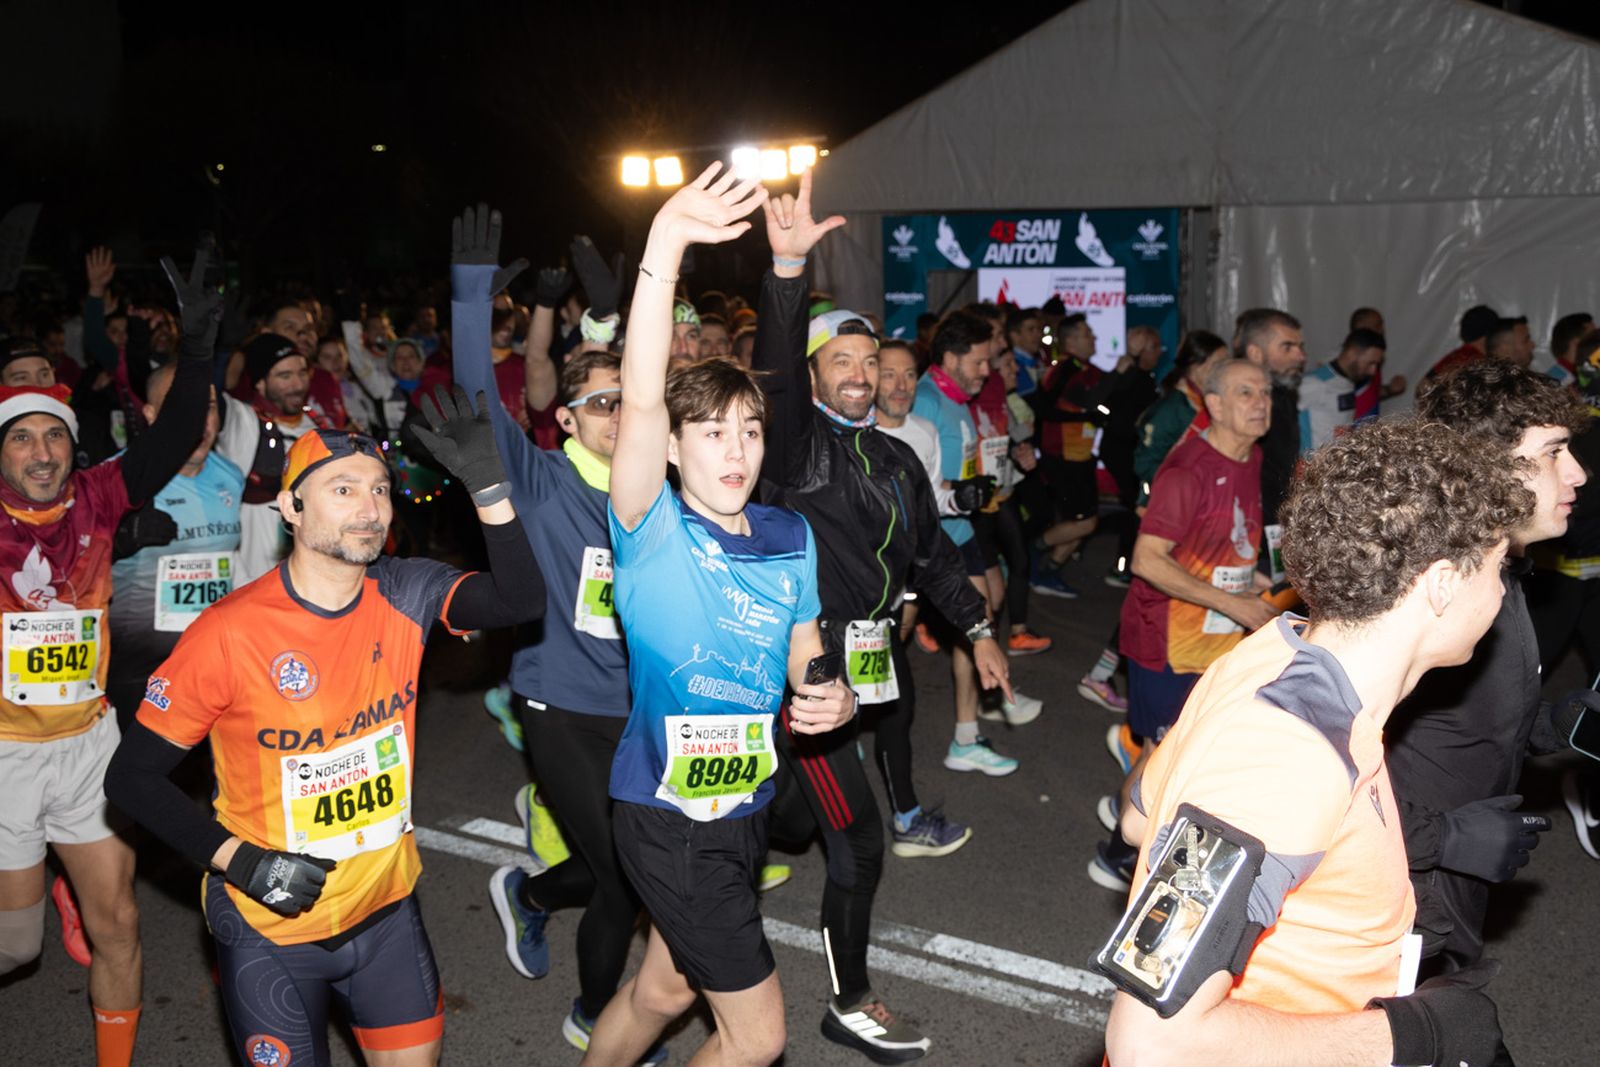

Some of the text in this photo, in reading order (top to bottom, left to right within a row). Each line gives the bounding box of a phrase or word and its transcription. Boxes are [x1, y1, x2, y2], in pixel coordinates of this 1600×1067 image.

[1015, 219, 1062, 241] SAN
[983, 239, 1057, 265] ANTÓN
[171, 581, 228, 604] 12163
[31, 621, 75, 632] NOCHE DE
[27, 644, 88, 673] 6542
[257, 728, 325, 750] CDA
[695, 729, 729, 740] NOCHE
[730, 728, 739, 739] DE
[682, 743, 706, 755] SAN
[315, 758, 351, 779] NOCHE
[353, 752, 367, 767] DE
[686, 755, 758, 788] 8984
[300, 781, 327, 797] SAN
[313, 773, 394, 827] 4648
